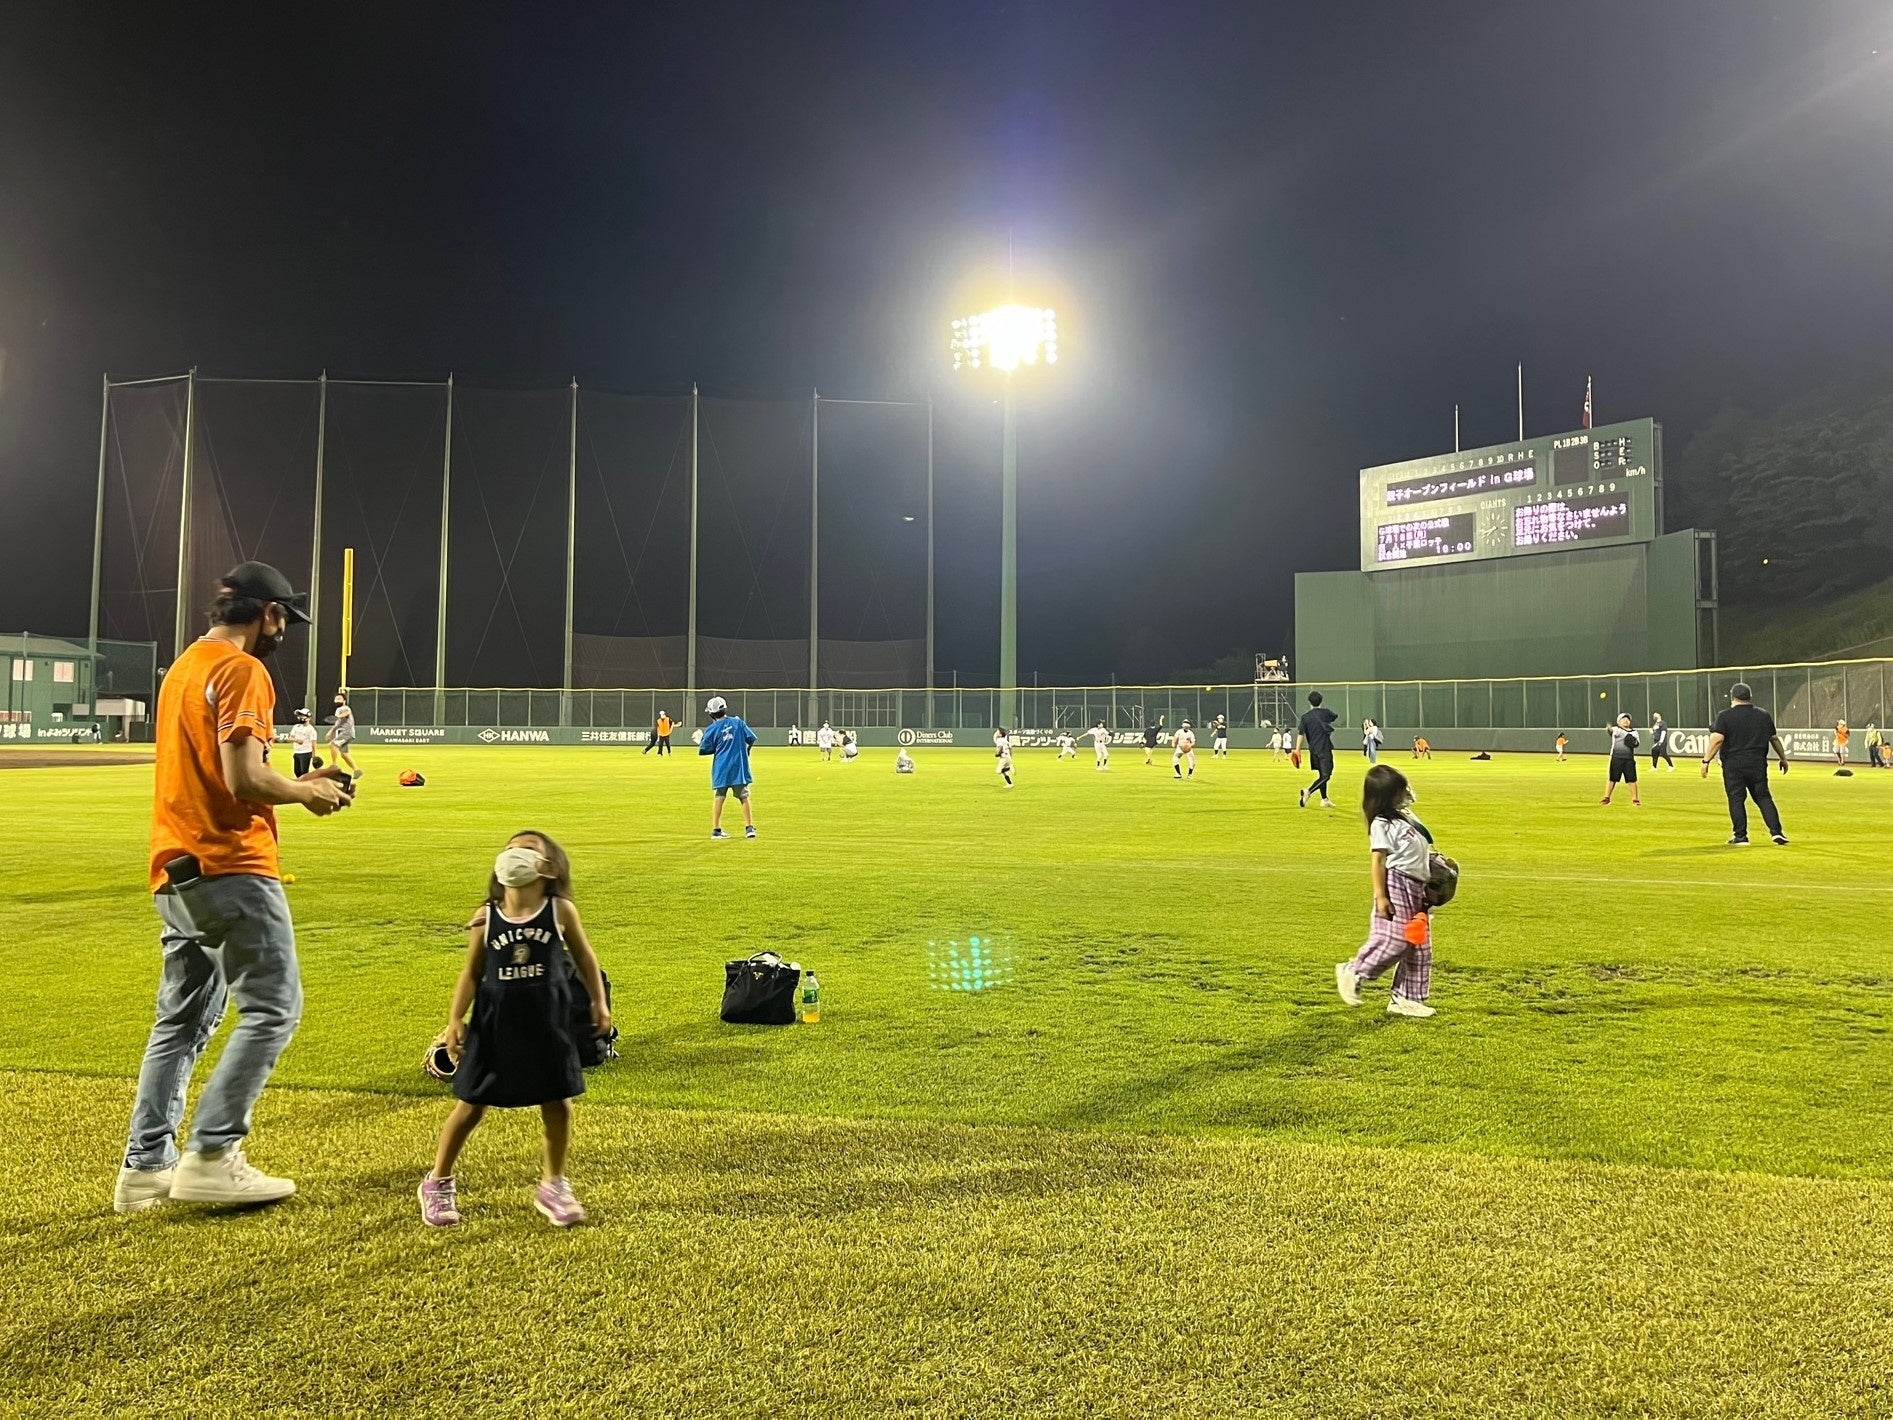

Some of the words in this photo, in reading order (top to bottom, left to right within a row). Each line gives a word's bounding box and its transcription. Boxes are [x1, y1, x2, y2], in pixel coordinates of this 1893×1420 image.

[1625, 466, 1646, 477] km/h
[1527, 494, 1532, 503] 1
[1537, 493, 1543, 502] 2
[1547, 492, 1552, 500] 3
[1557, 490, 1563, 499] 4
[1567, 489, 1573, 497] 5
[1577, 487, 1583, 496] 6
[1588, 486, 1594, 495] 7
[1598, 484, 1605, 493] 8
[1609, 482, 1616, 491] 9
[1480, 498, 1507, 510] GIANTS
[370, 727, 407, 736] MARKET
[409, 728, 445, 737] SQUARE
[501, 730, 550, 742] HANWA
[498, 963, 546, 980] LEAGUE
